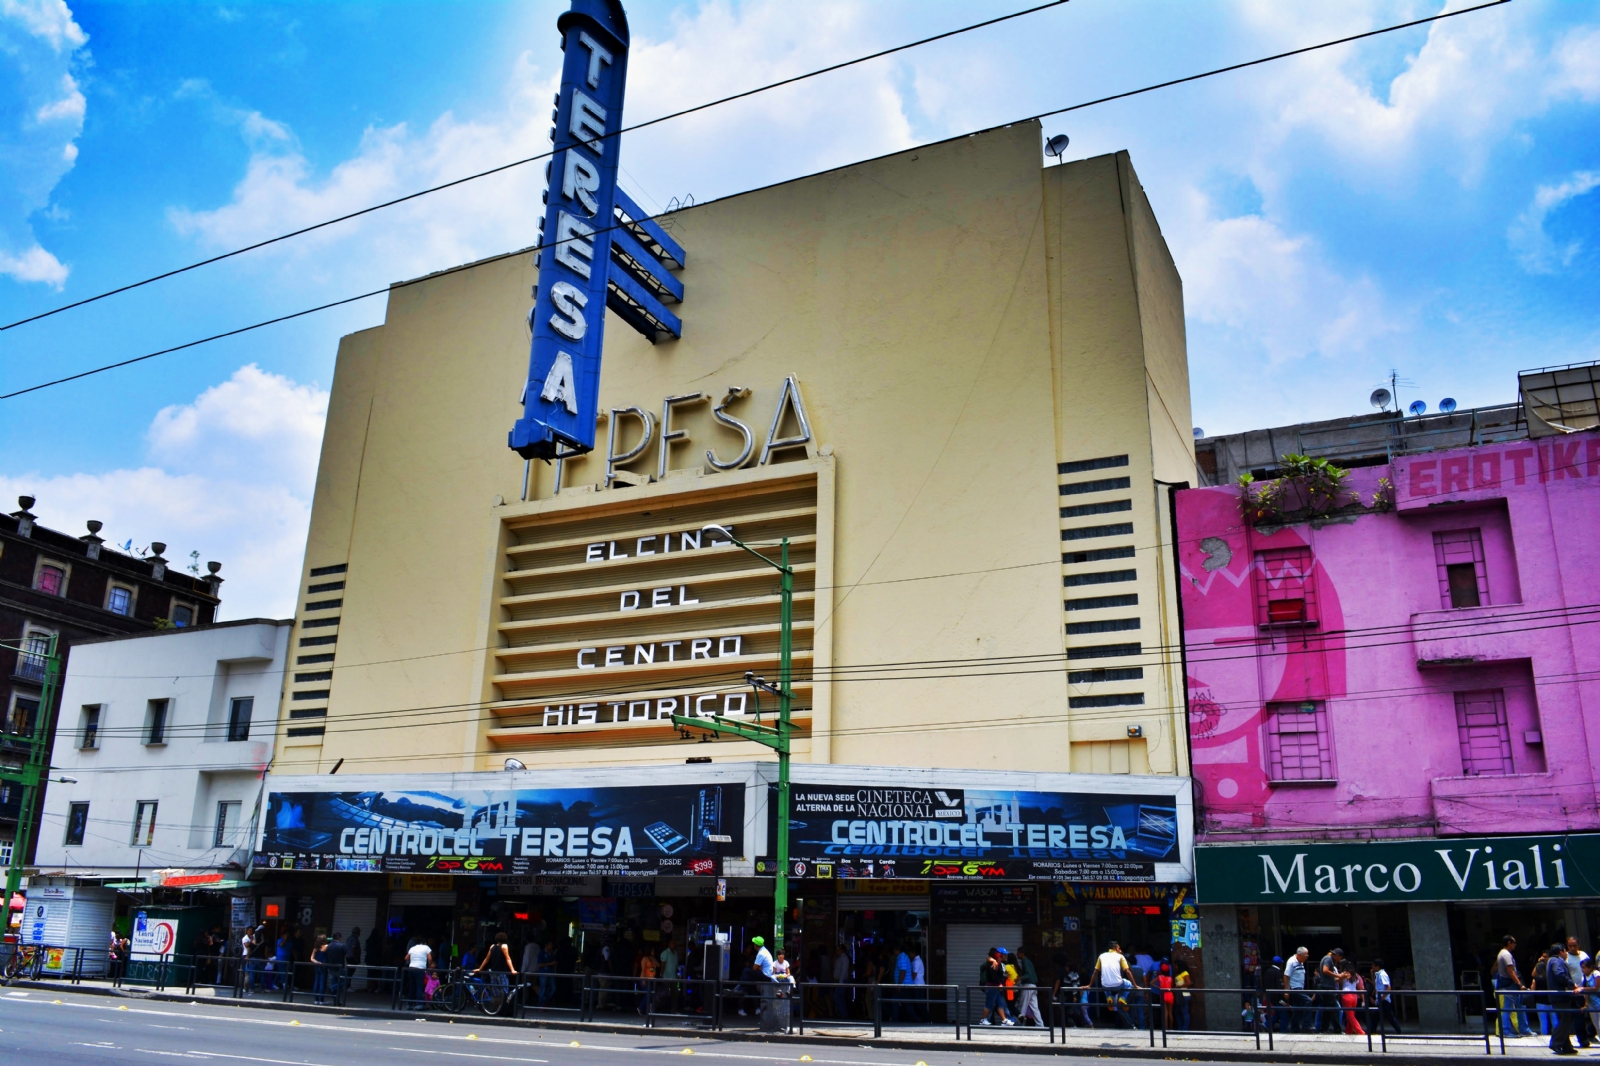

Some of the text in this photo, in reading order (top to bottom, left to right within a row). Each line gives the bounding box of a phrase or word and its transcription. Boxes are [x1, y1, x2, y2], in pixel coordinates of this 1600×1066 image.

[539, 31, 613, 415] TERESA
[586, 540, 628, 562] EL
[619, 585, 700, 611] DEL
[576, 636, 743, 670] CENTRO
[795, 793, 855, 802] LA NUEVA SEDE
[856, 789, 933, 804] CINETECA
[796, 804, 832, 812] ALTERNA
[833, 804, 844, 812] DE
[857, 804, 934, 818] NACIONAL
[339, 825, 635, 857] CENTROCEL TERESA
[831, 819, 1128, 849] CENTROCEL TERESA
[464, 860, 504, 871] GYM
[693, 860, 713, 872] $399
[962, 864, 1006, 876] GYM
[1258, 843, 1571, 895] Marco Viali
[500, 876, 587, 887] MUESTRA INTERNACIONAL
[532, 886, 568, 894] DE CINE
[610, 883, 652, 898] TERESA
[965, 888, 998, 897] WASON
[1094, 887, 1151, 899] AL MOMENTO
